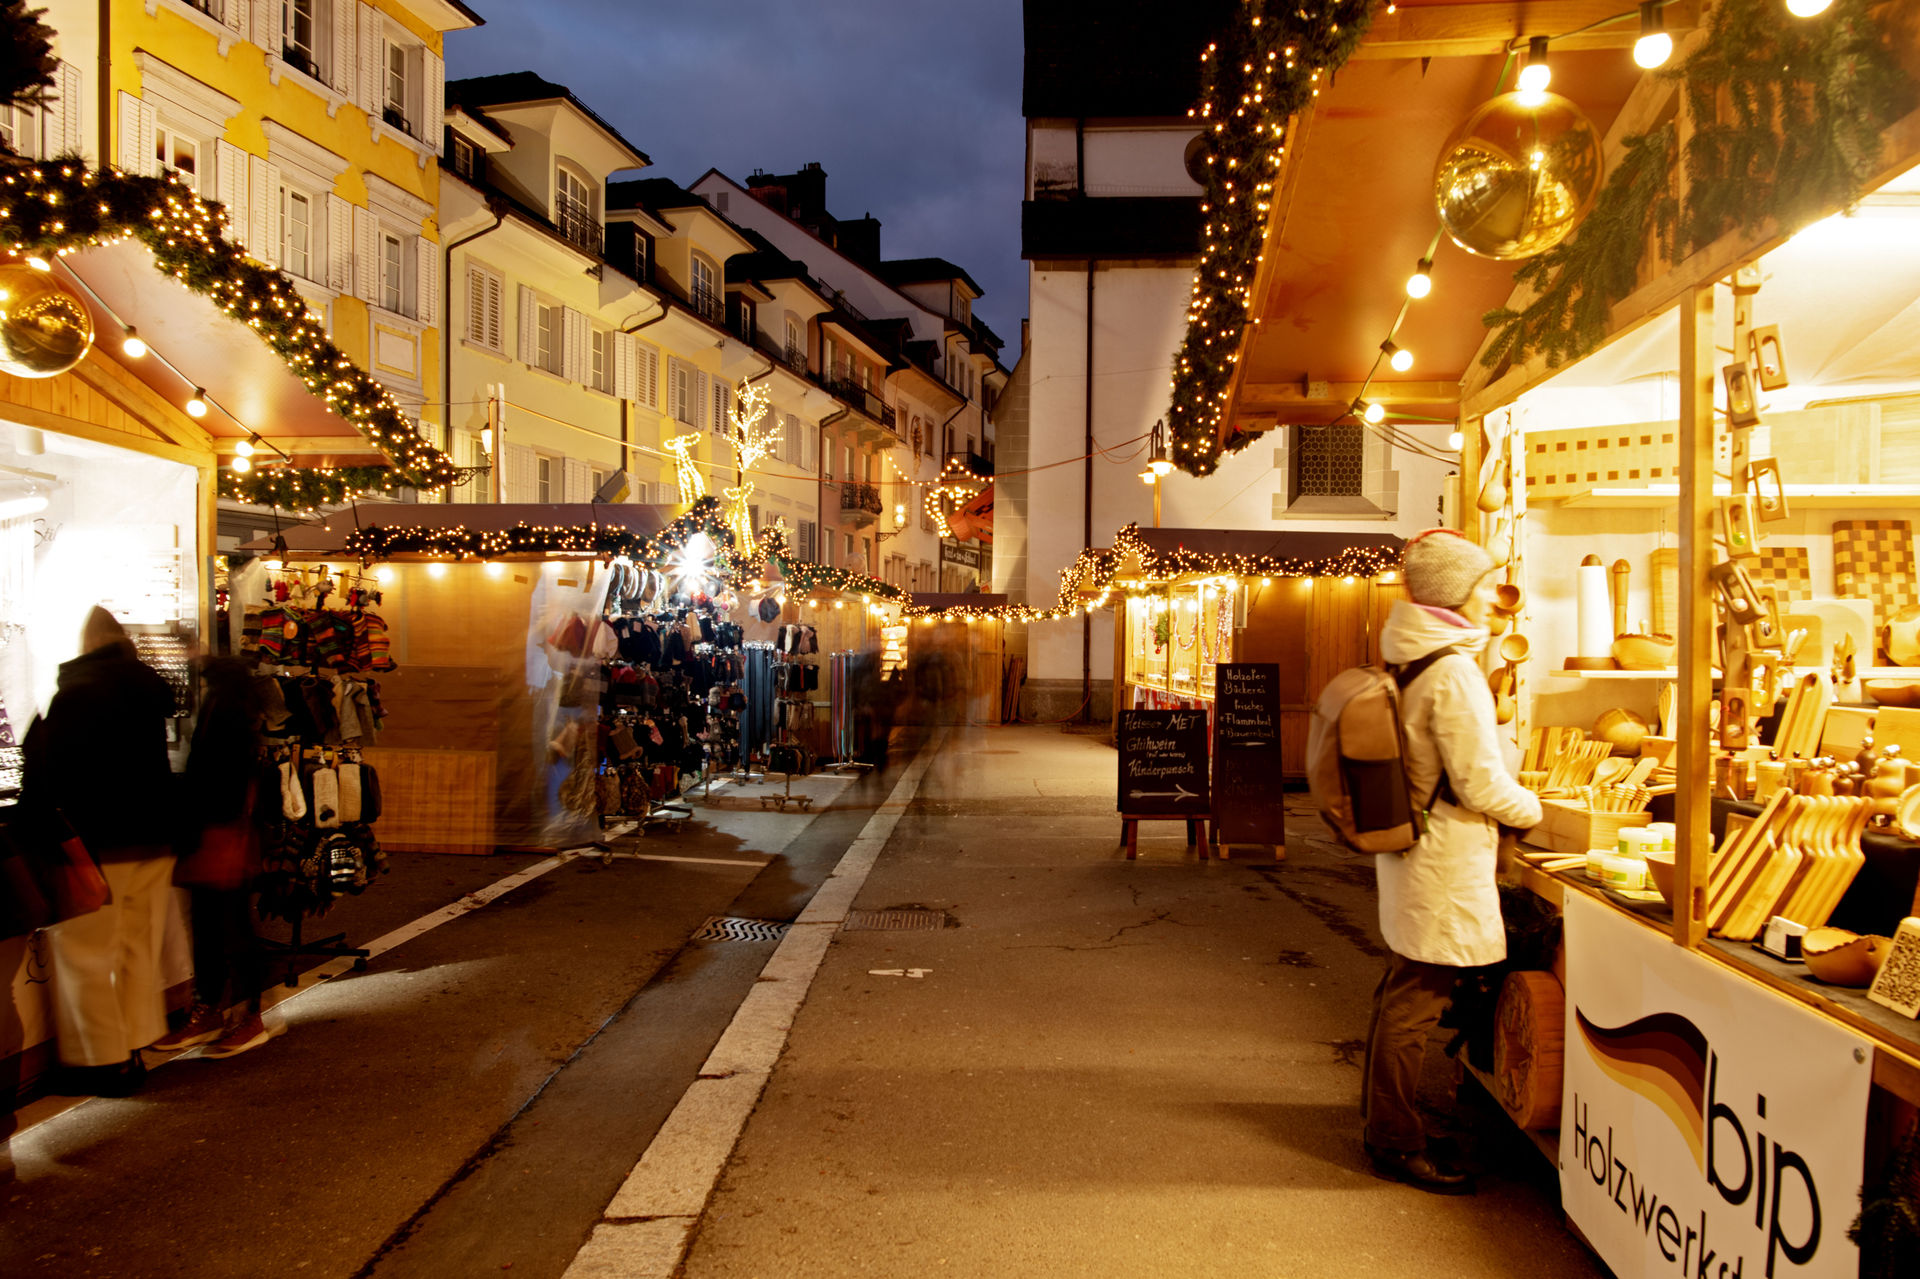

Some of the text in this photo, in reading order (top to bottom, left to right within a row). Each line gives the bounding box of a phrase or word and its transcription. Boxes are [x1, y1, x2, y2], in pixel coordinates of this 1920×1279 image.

[1166, 712, 1201, 731] MET
[1126, 736, 1177, 752] Glühwein
[1127, 758, 1195, 780] Kinderpunsch
[1706, 1047, 1822, 1279] bip
